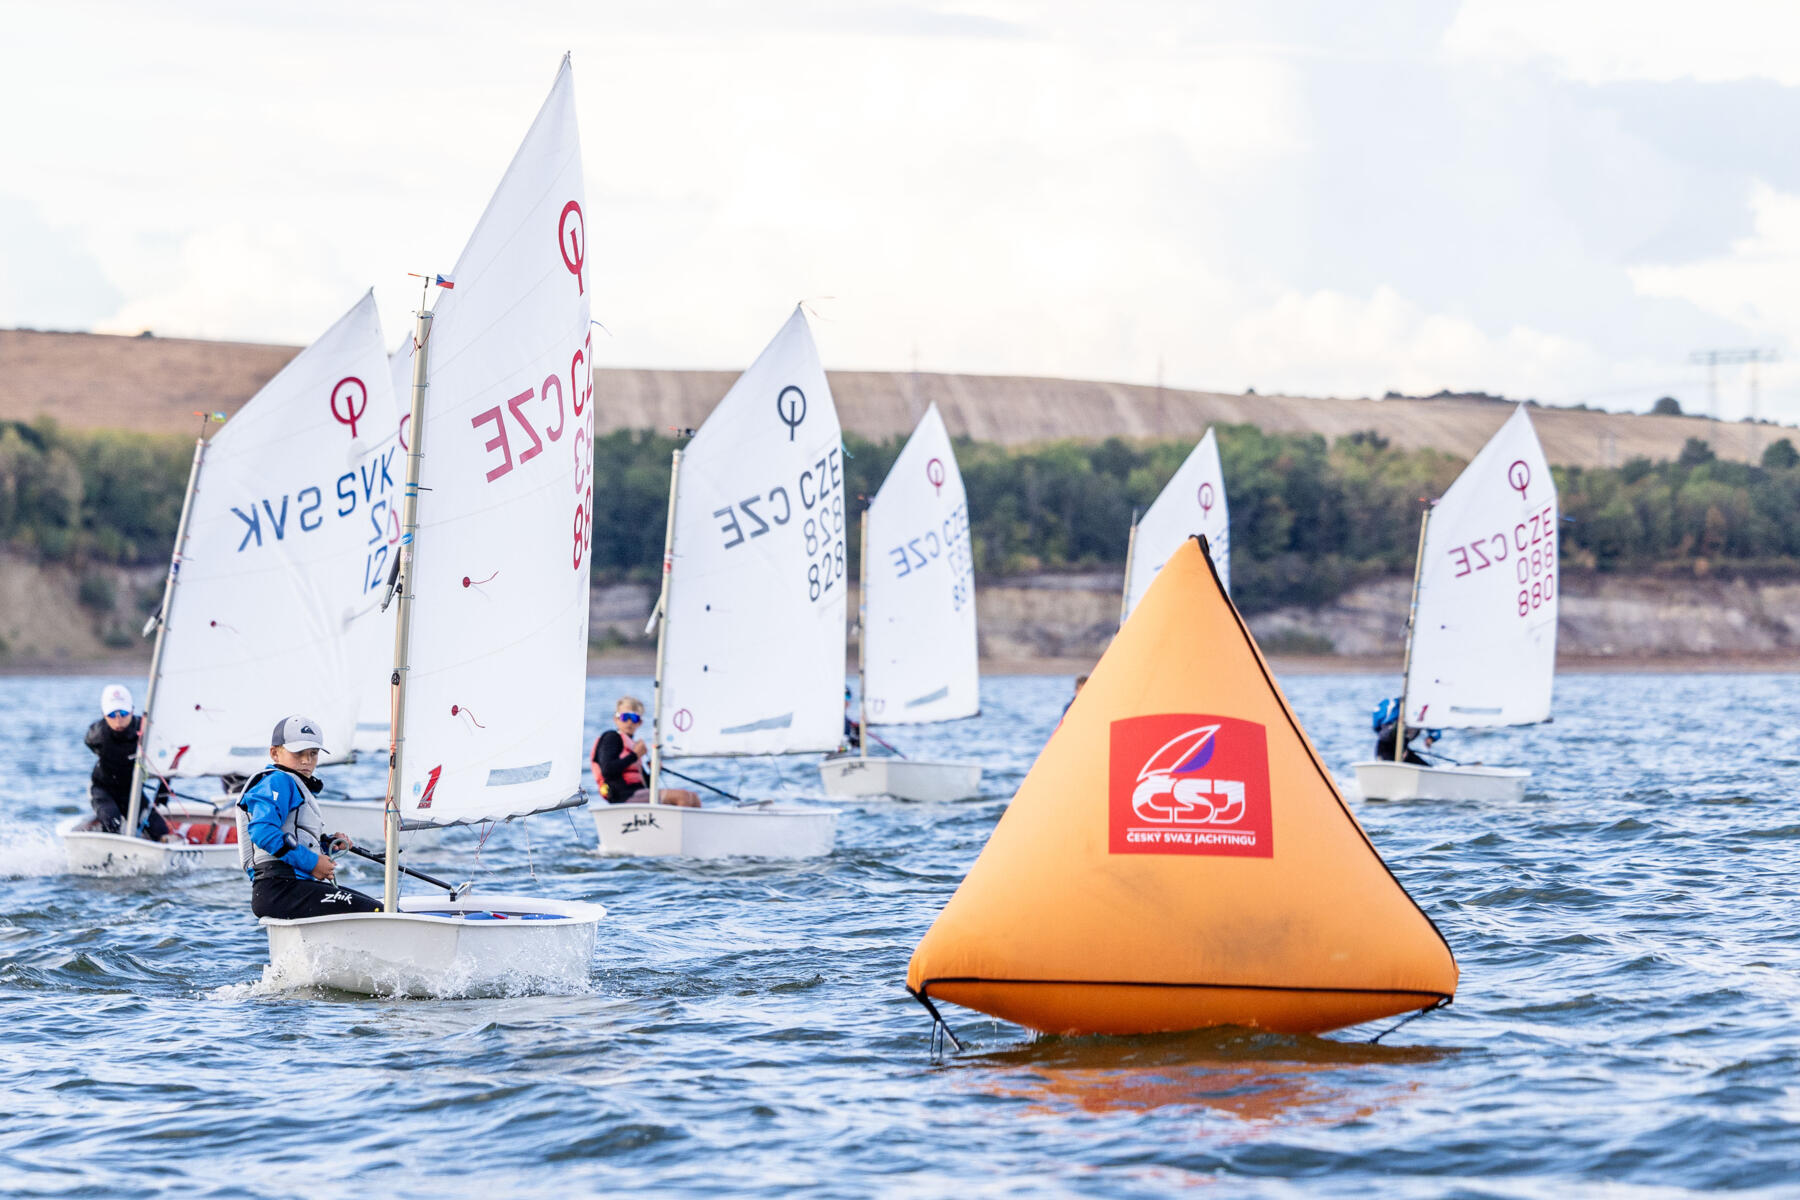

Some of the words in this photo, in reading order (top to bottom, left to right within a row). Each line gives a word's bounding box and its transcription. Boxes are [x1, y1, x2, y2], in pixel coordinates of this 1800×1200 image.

[571, 330, 592, 417] CZ
[337, 446, 395, 517] SVK
[800, 447, 840, 510] CZE
[573, 485, 591, 570] 88
[1514, 506, 1554, 552] CZE
[364, 545, 388, 594] 12
[808, 540, 844, 602] 828
[1518, 573, 1553, 617] 880
[1126, 831, 1162, 843] ČESKÝ
[1164, 833, 1192, 844] SVAZ
[1194, 833, 1256, 846] JACHTINGU
